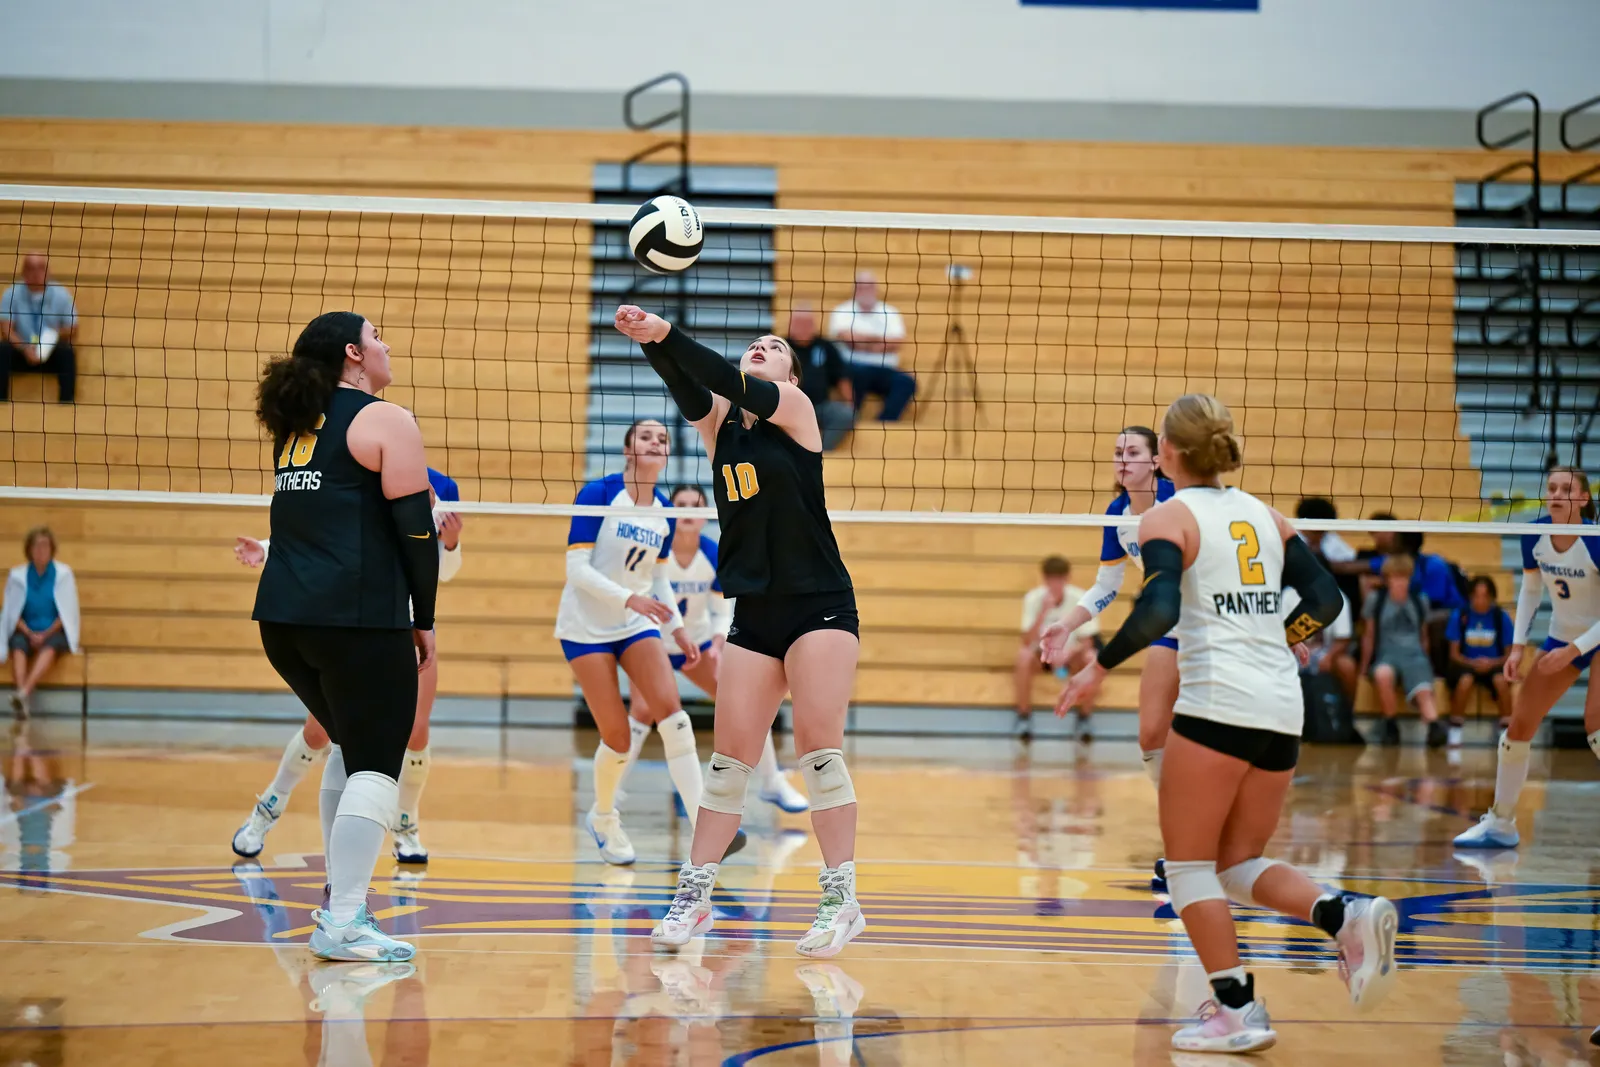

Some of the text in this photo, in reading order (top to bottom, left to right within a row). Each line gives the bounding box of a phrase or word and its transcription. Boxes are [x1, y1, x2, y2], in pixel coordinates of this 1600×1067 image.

[275, 470, 322, 492] NTHERS
[722, 462, 760, 502] 10
[625, 546, 646, 572] 11
[1228, 521, 1266, 586] 2
[1554, 579, 1571, 600] 3
